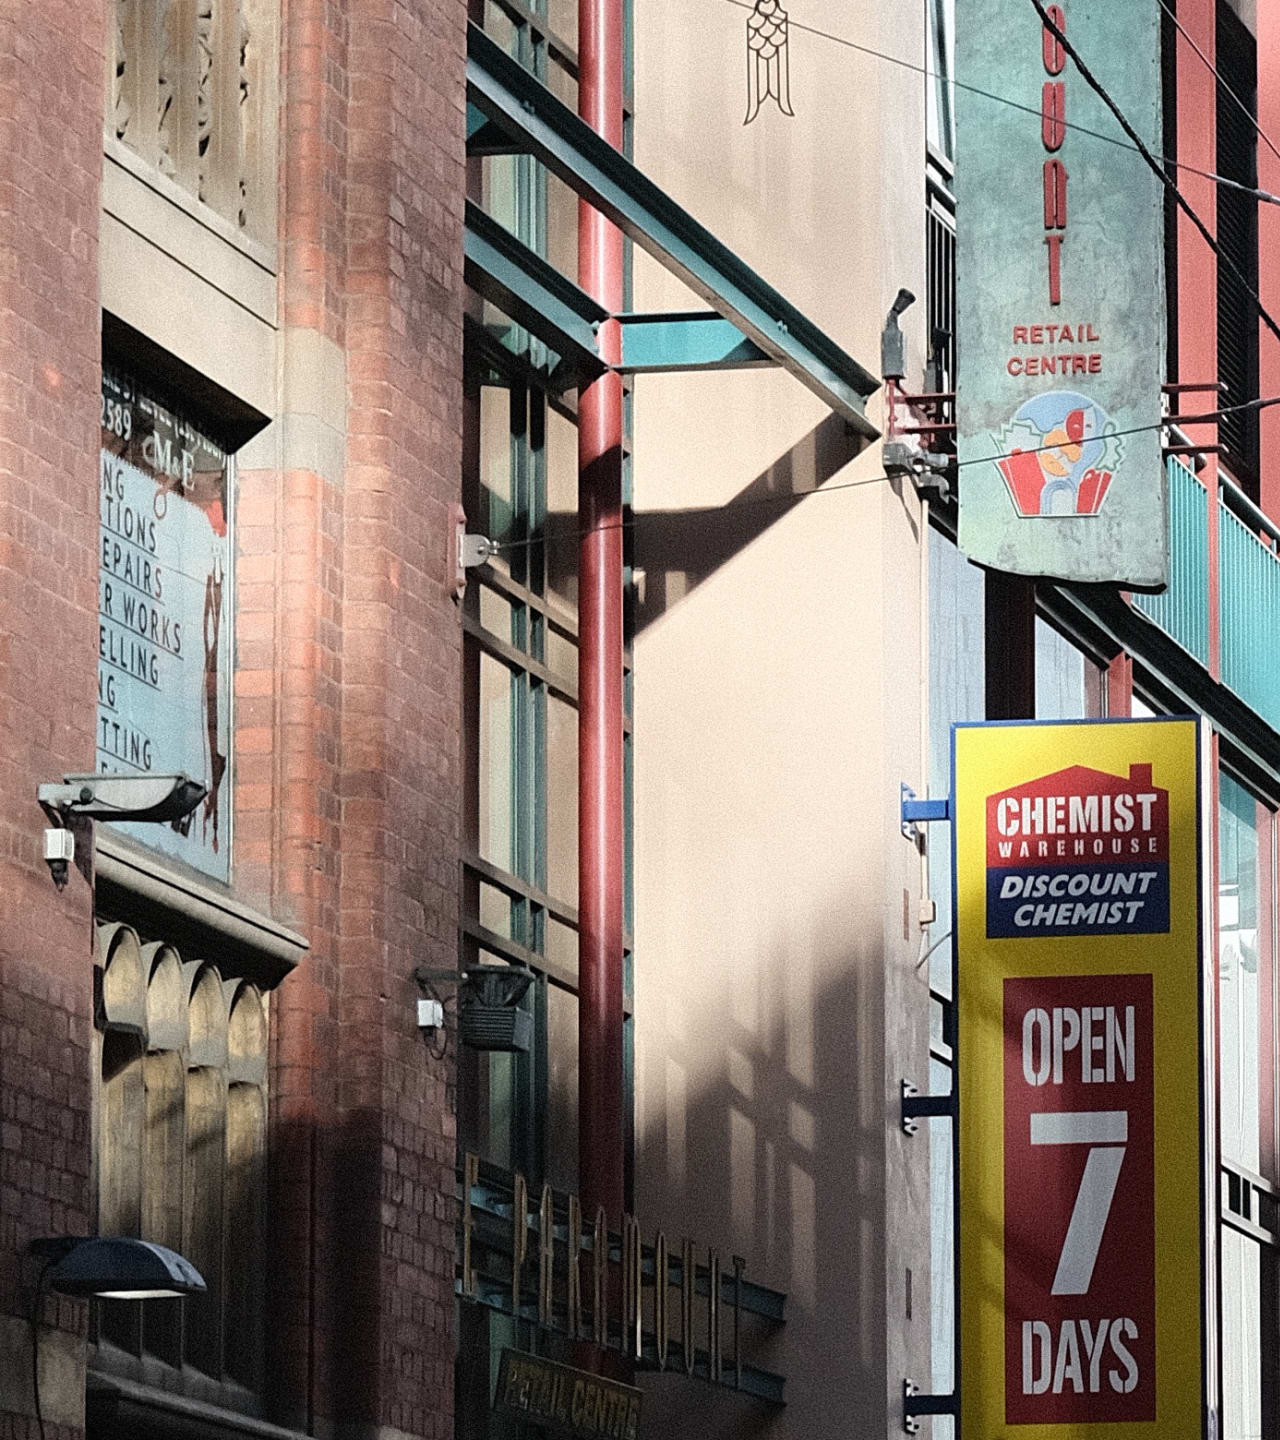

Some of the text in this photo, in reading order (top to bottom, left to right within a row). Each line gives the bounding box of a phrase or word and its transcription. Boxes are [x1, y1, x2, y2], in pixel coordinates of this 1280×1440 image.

[1013, 323, 1101, 345] RETAIL
[1006, 354, 1103, 378] CENTRE
[100, 495, 156, 553] TIONS
[123, 591, 182, 654] WORKS
[995, 793, 1158, 836] CHEMIST
[998, 838, 1159, 858] WAREHOUSE
[1000, 870, 1158, 899] DISCOUNT
[1012, 900, 1145, 928] CHEMIST
[1022, 1005, 1136, 1088] OPEN
[1029, 1109, 1129, 1297] 7
[1021, 1316, 1140, 1397] DAYS
